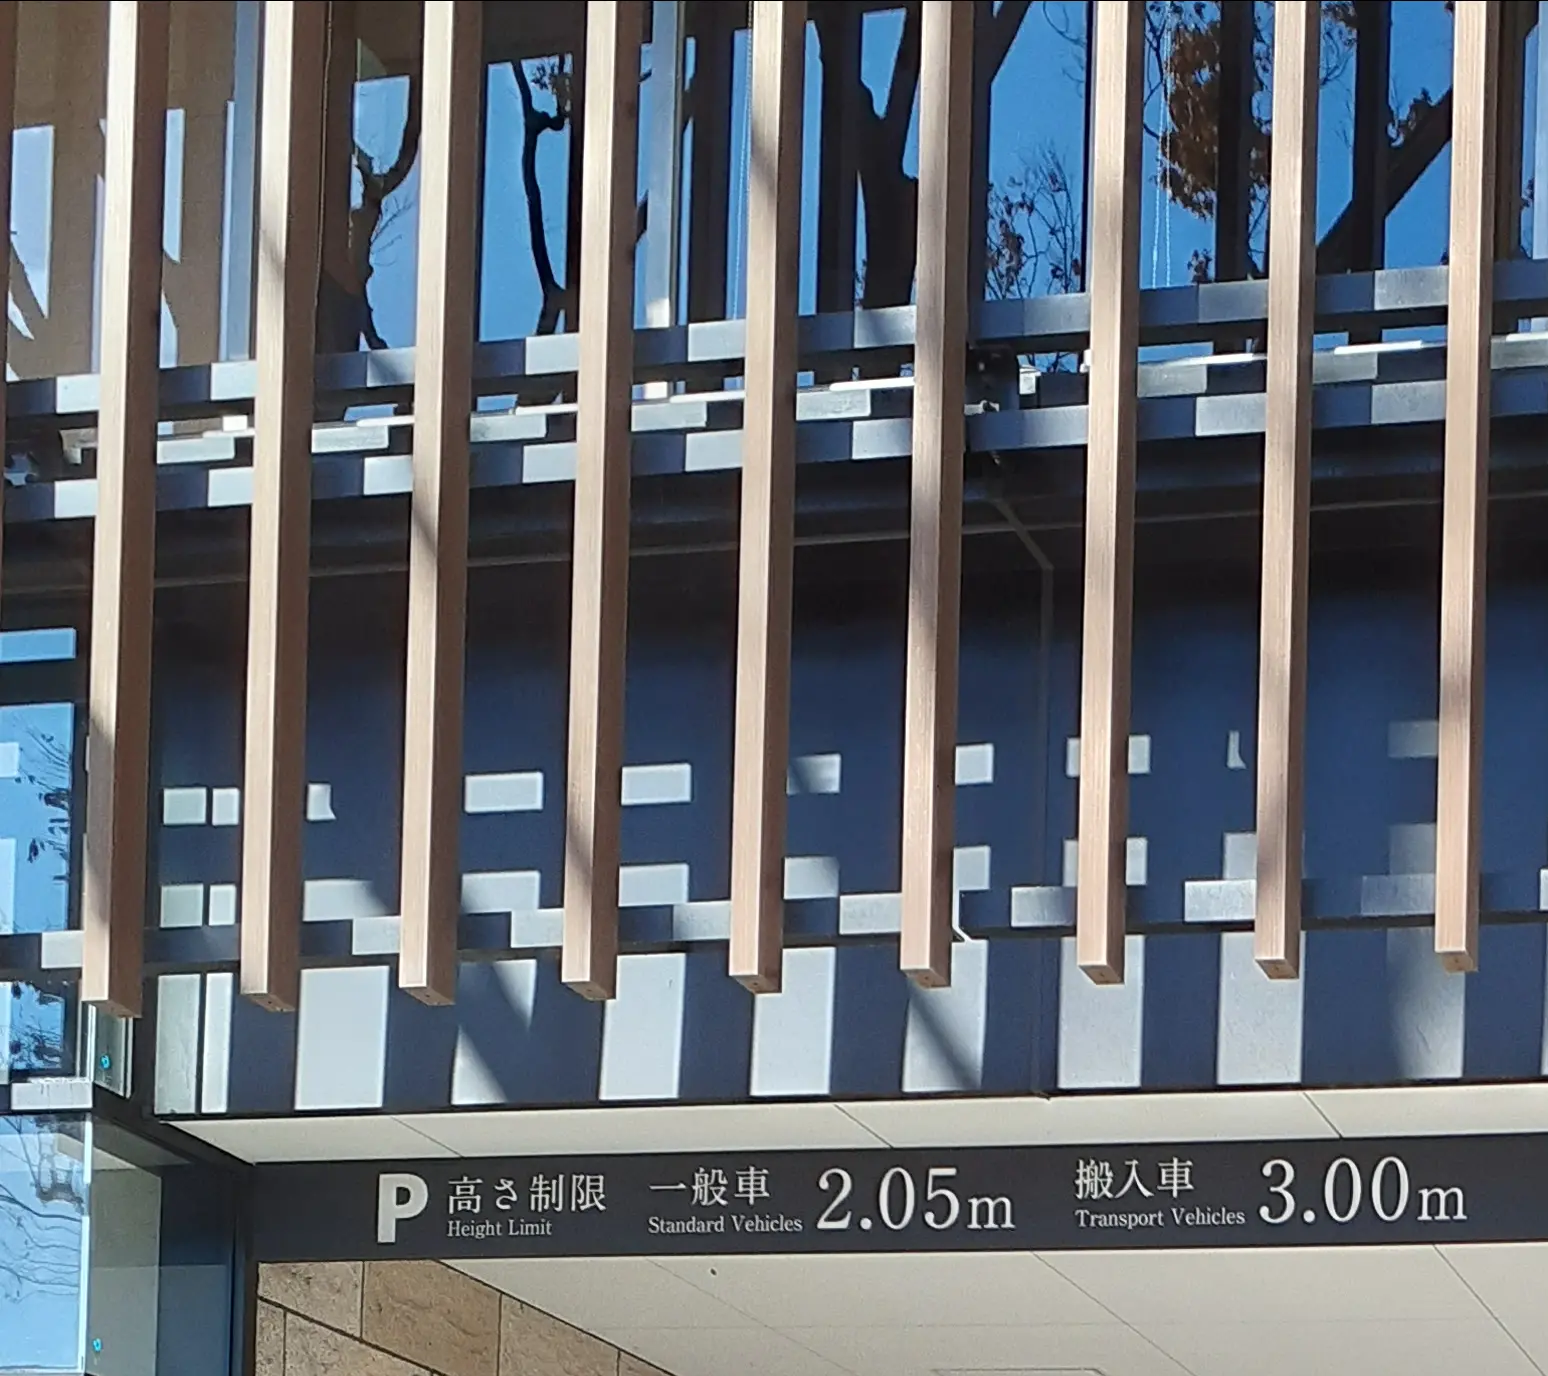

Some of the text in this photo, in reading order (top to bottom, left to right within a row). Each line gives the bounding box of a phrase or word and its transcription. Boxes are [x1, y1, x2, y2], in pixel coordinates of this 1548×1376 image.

[447, 1173, 607, 1214] 高さ制限
[649, 1165, 770, 1206] 一般車
[816, 1167, 1016, 1230] 2.05m
[1075, 1156, 1195, 1200] 搬入車
[1258, 1156, 1468, 1224] 3.00m
[377, 1173, 429, 1244] P
[447, 1218, 553, 1239] Height Limit
[648, 1213, 804, 1234] Standard Vehicles
[1074, 1206, 1246, 1230] Transport Vehicles
